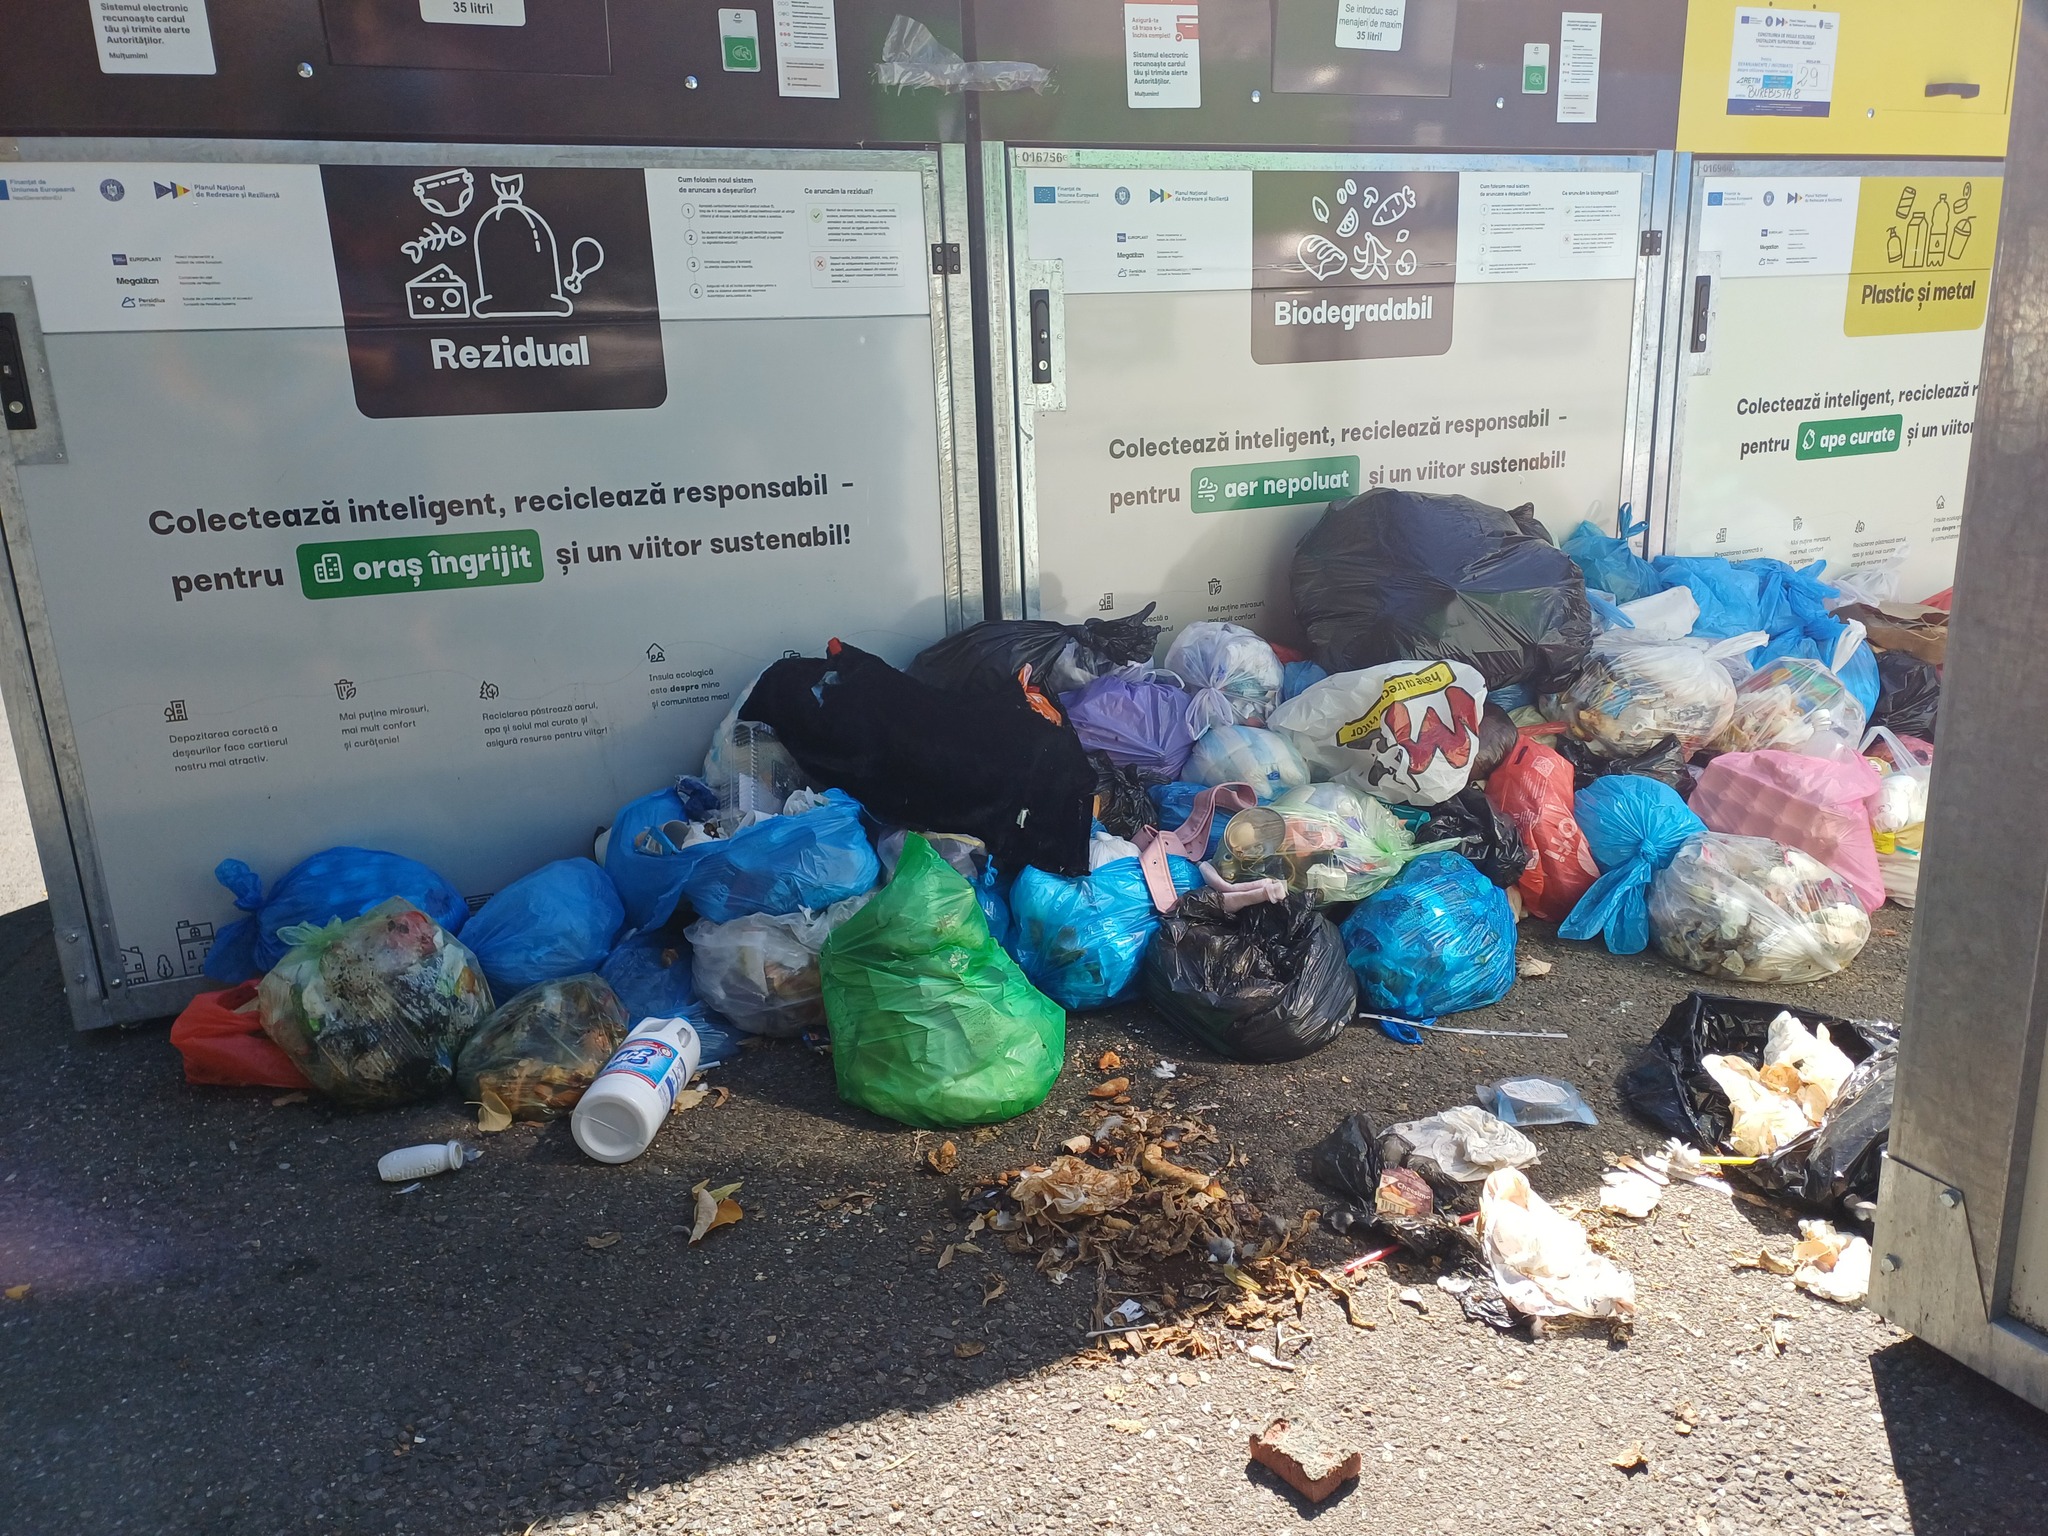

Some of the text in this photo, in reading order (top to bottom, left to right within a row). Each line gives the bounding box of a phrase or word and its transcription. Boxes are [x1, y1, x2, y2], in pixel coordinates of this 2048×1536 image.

[101, 3, 189, 12] Sistemul electronic
[453, 2, 493, 14] 35 litri!
[1345, 3, 1398, 16] Se introduc saci
[102, 15, 185, 24] recunoaște cardul
[1339, 17, 1402, 29] menajeri de maxim
[105, 25, 119, 33] tău
[121, 25, 129, 34] și
[164, 26, 190, 34] alerte
[1356, 31, 1382, 41] 35 litri!
[107, 36, 164, 45] Autorităților.
[109, 52, 148, 60] Mulțumim!
[1797, 66, 1818, 87] 29
[1022, 151, 1063, 162] 016756
[732, 176, 753, 184] sistem
[722, 187, 757, 195] deșeurilor?
[814, 187, 840, 195] aruncăm
[1861, 280, 1976, 311] Plastic și metal
[1274, 295, 1433, 330] Biodegradabil
[430, 335, 590, 370] Rezidual
[1737, 381, 1969, 416] Colectează inteligent, reciclează
[1109, 408, 1550, 459] Colectează inteligent, reciclează responsabil
[1740, 438, 1790, 461] pentru
[1820, 433, 1846, 452] ape
[1849, 426, 1896, 446] curate
[1907, 423, 1918, 447] și
[1921, 424, 1937, 438] un
[1110, 486, 1180, 514] pentru
[1224, 479, 1259, 498] aer
[1263, 470, 1349, 499] nepoluat
[1389, 466, 1412, 484] un
[1417, 460, 1466, 481] viitor
[1470, 450, 1566, 475] sustenabil!
[149, 473, 828, 535] Colectează inteligent, reciclează responsabil
[172, 524, 851, 602] pentru oraș îngrijit și un viitor sustenabil!
[649, 668, 714, 681] Insula ecologică
[650, 681, 720, 695] este despre mine
[651, 692, 730, 710] și comunitatea mea!
[339, 704, 430, 722] Mai puține mirosuri,
[482, 710, 528, 721] Reciclarea
[530, 704, 573, 718] păstrează
[341, 719, 416, 735] mai mult confort
[484, 716, 588, 735] apa și solul mai curate și
[169, 731, 230, 744] Depozitarea
[232, 724, 270, 737] corectă
[486, 726, 608, 748] asigură resurse pentru viitor!
[172, 738, 288, 759] deșeurilor face cartierul
[344, 740, 352, 751] și
[174, 754, 268, 772] nostru mai atractiv.
[614, 1049, 653, 1063] ACE
